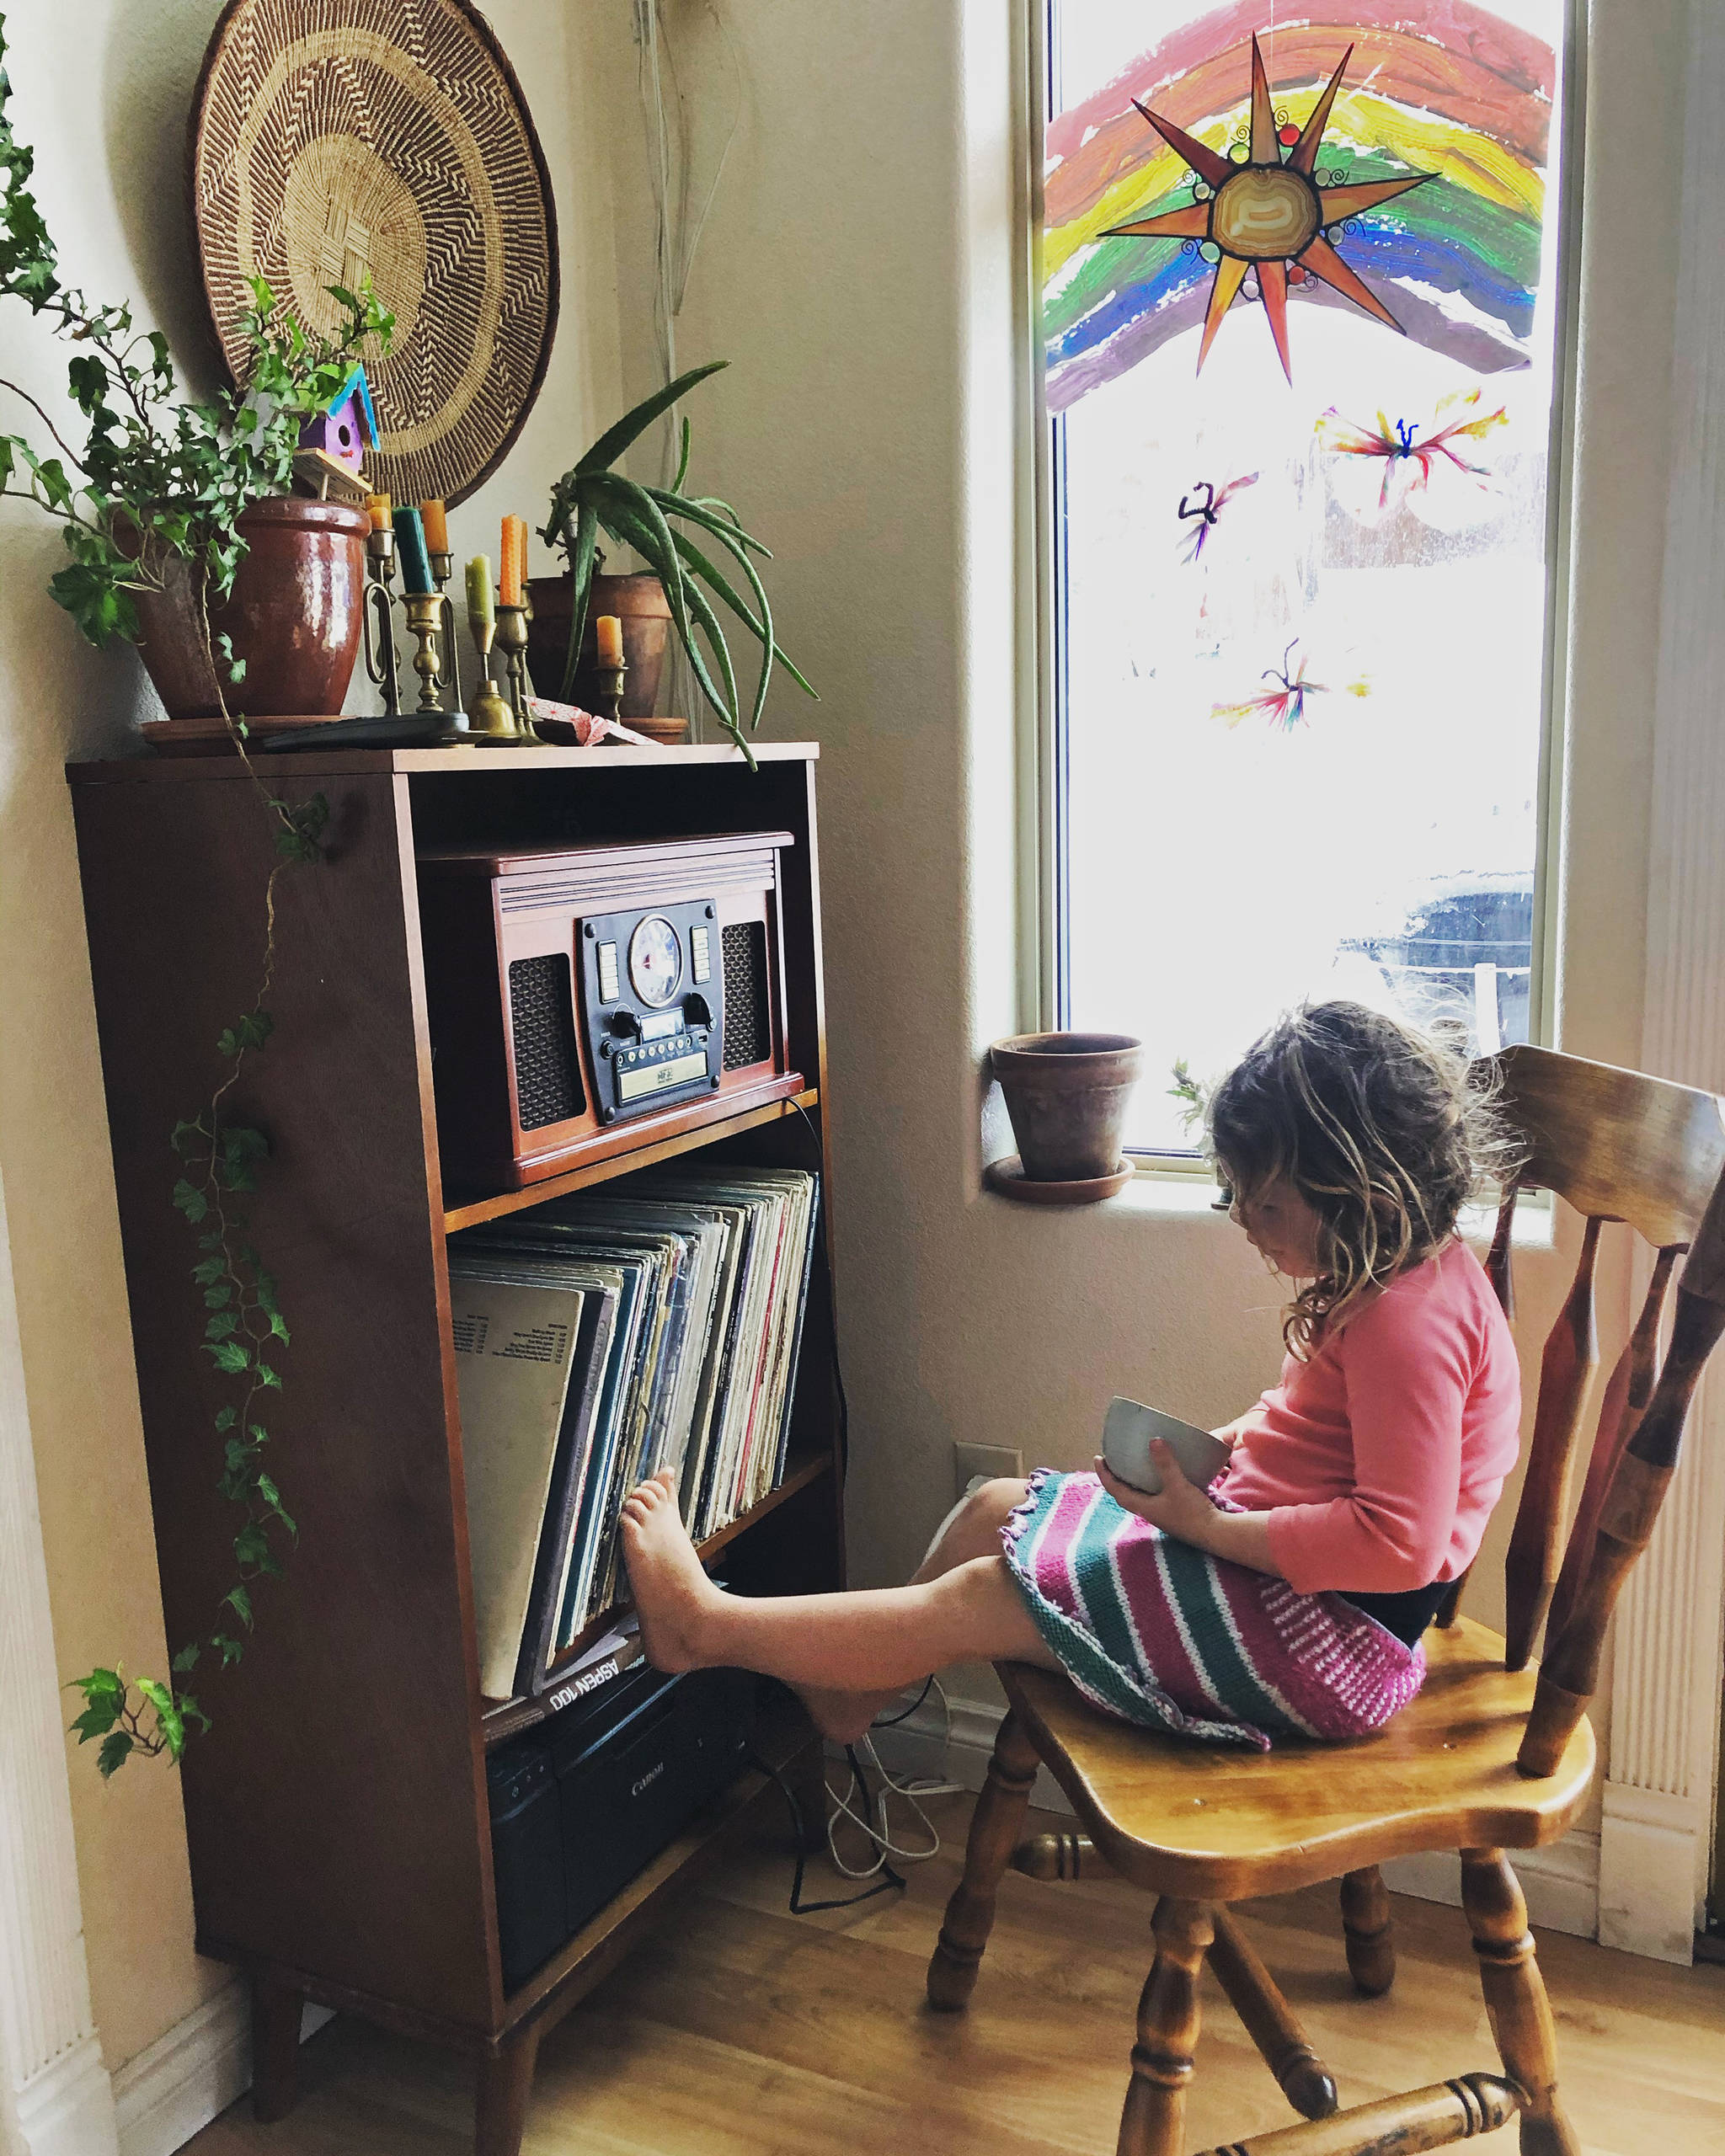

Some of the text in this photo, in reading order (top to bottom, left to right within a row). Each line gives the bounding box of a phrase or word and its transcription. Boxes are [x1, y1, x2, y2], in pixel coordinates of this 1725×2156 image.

[574, 1657, 620, 1695] ASPEN
[549, 1684, 579, 1710] 100
[632, 1762, 664, 1796] Canon
